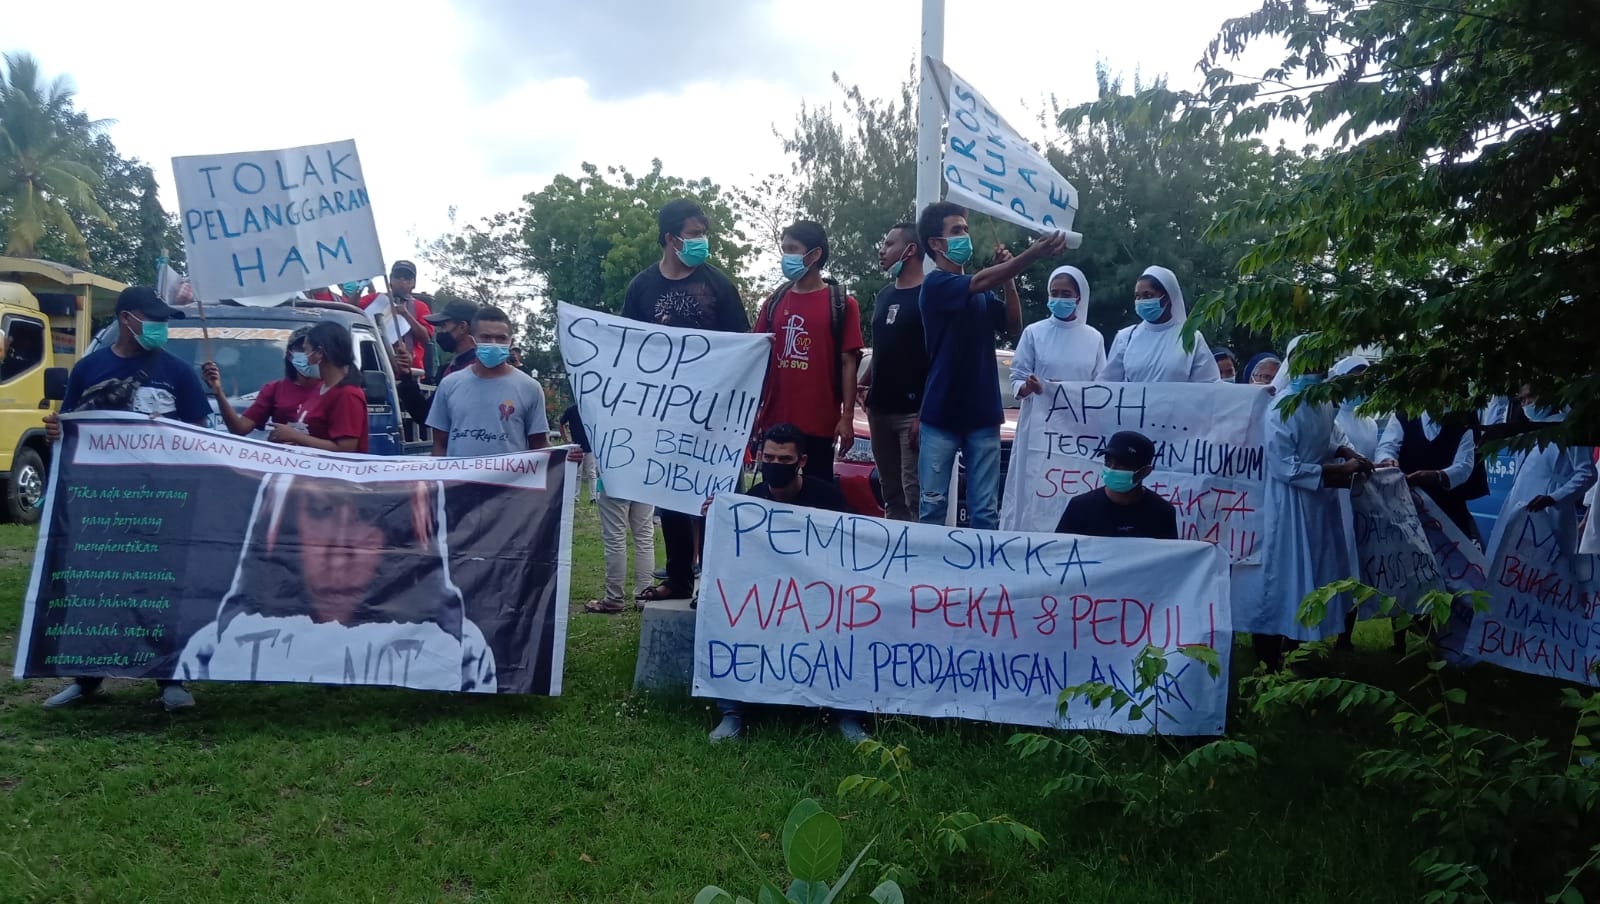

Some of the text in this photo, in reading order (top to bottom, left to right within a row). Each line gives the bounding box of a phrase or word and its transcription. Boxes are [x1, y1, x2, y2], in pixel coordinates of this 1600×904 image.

[198, 150, 357, 198] TOLAK
[185, 187, 370, 244] PELANGGARAN
[232, 235, 353, 287] HAM
[566, 317, 711, 380] STOP
[790, 360, 809, 370] SVD
[567, 370, 756, 436] IPU-TIPU!!!
[88, 433, 539, 475] MANUSIA BUKAN BARANG UNTUK DIPERJUAL-BELIKAN
[654, 429, 742, 468] BELUM
[1044, 431, 1265, 481] TEGAAN HUKUM
[99, 487, 121, 503] ada
[155, 490, 190, 508] orang
[81, 511, 163, 533] yang berjuang
[728, 502, 1103, 587] PEMDA SIKKA
[74, 539, 160, 560] menghentikan
[52, 566, 176, 587] perdagangan manusia,
[46, 592, 171, 616] pastikan bahwa anda
[716, 577, 882, 634] WAJIB
[910, 584, 1018, 639] PEKA
[1070, 594, 1216, 650] PEDULI
[44, 621, 164, 641] adalah salah satu di
[1478, 620, 1576, 673] BUKAN
[44, 652, 84, 665] antara
[85, 652, 129, 666] mereka
[708, 634, 855, 691] DENGAN
[868, 641, 1068, 700] PERDAGANGAN
